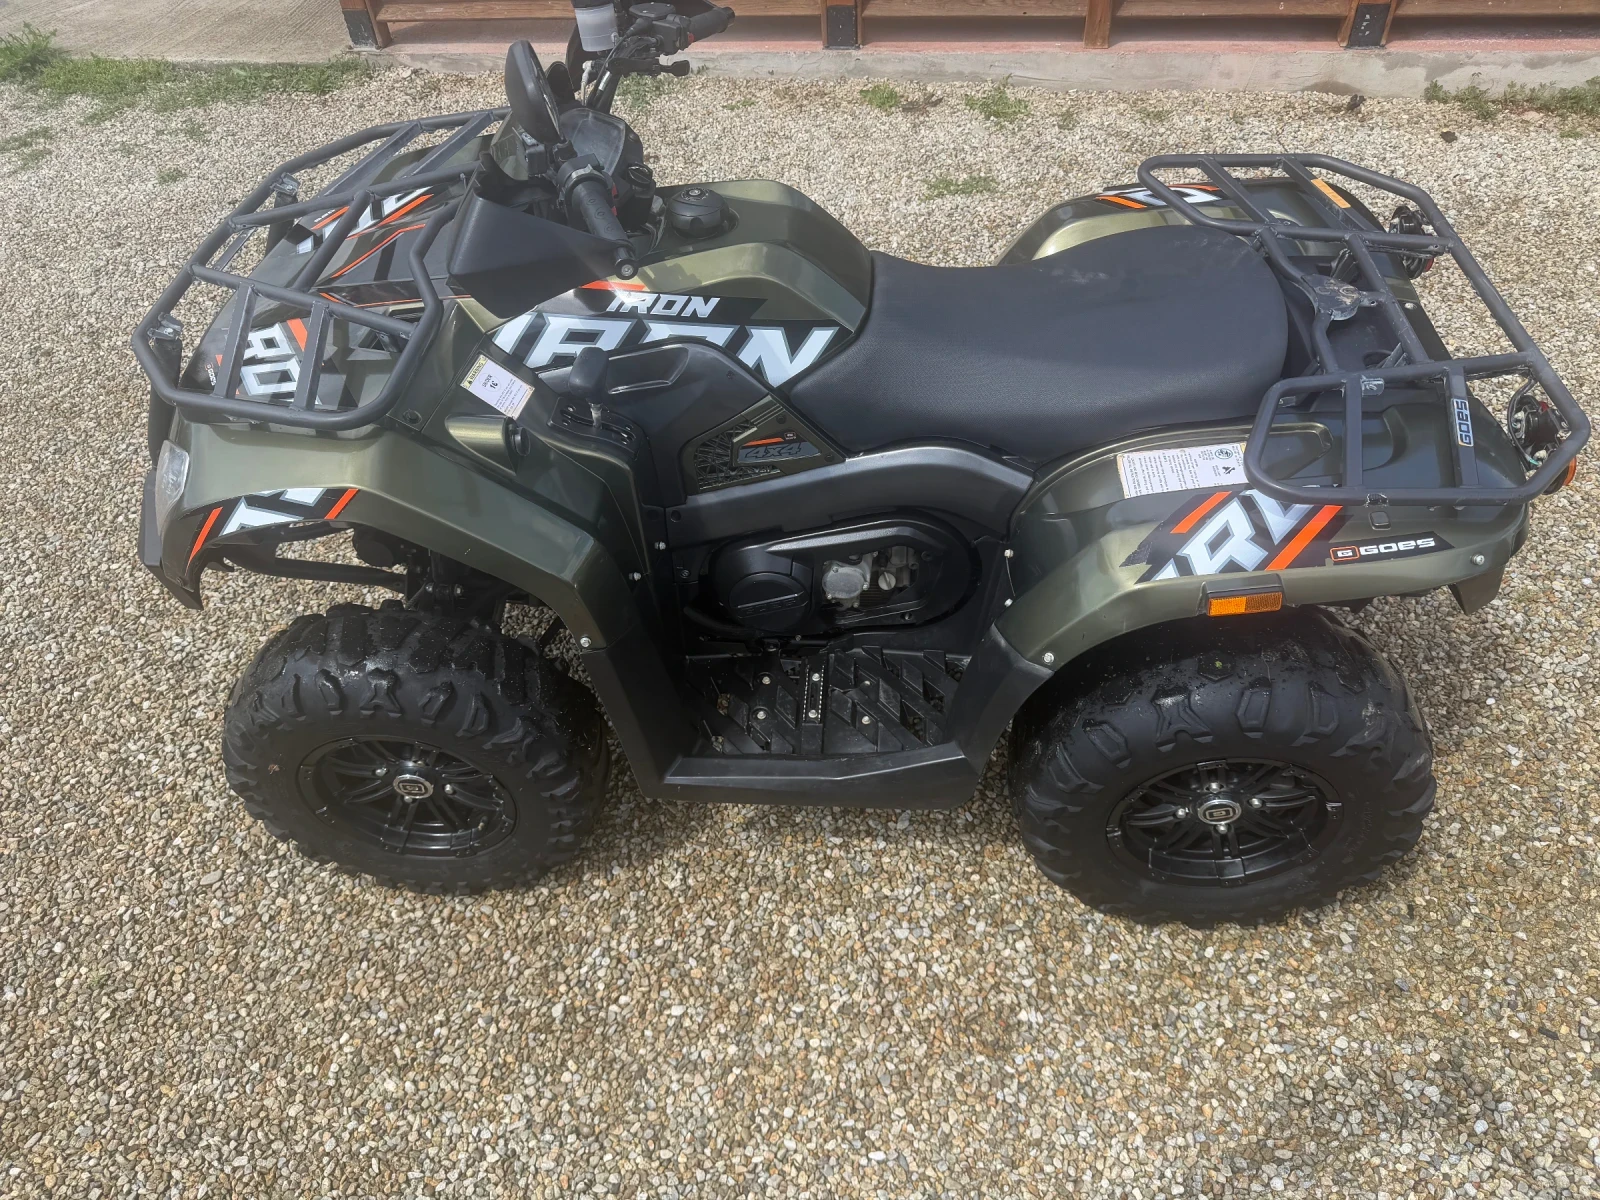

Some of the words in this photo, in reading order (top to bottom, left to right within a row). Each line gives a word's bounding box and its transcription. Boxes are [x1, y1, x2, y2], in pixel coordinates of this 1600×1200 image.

[606, 289, 721, 318] IRON
[491, 312, 840, 389] IRN
[1455, 399, 1472, 445] GOES
[1359, 538, 1436, 555] GOES
